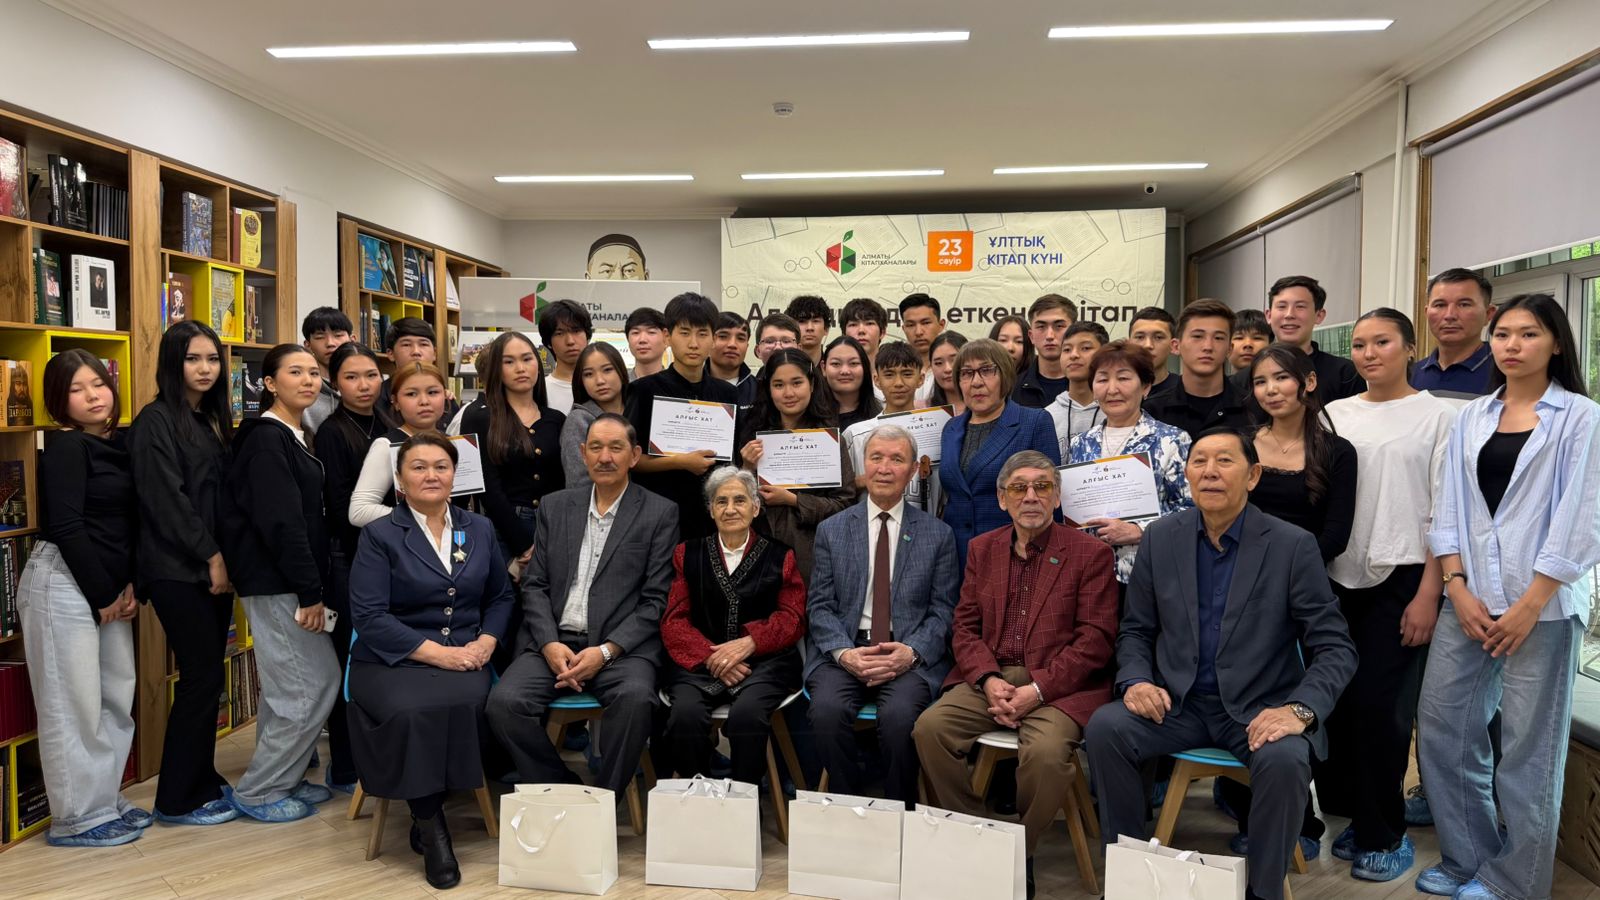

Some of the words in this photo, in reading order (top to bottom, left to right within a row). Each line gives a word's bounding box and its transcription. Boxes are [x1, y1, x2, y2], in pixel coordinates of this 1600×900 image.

[938, 238, 962, 256] 23
[988, 235, 1046, 249] ҰЛТТЫҚ
[987, 253, 1026, 265] КІТАП
[1031, 253, 1063, 265] КҮНІ
[946, 306, 1026, 324] еткен
[1077, 300, 1138, 322] ітап
[1082, 475, 1109, 484] АЛҒЫС
